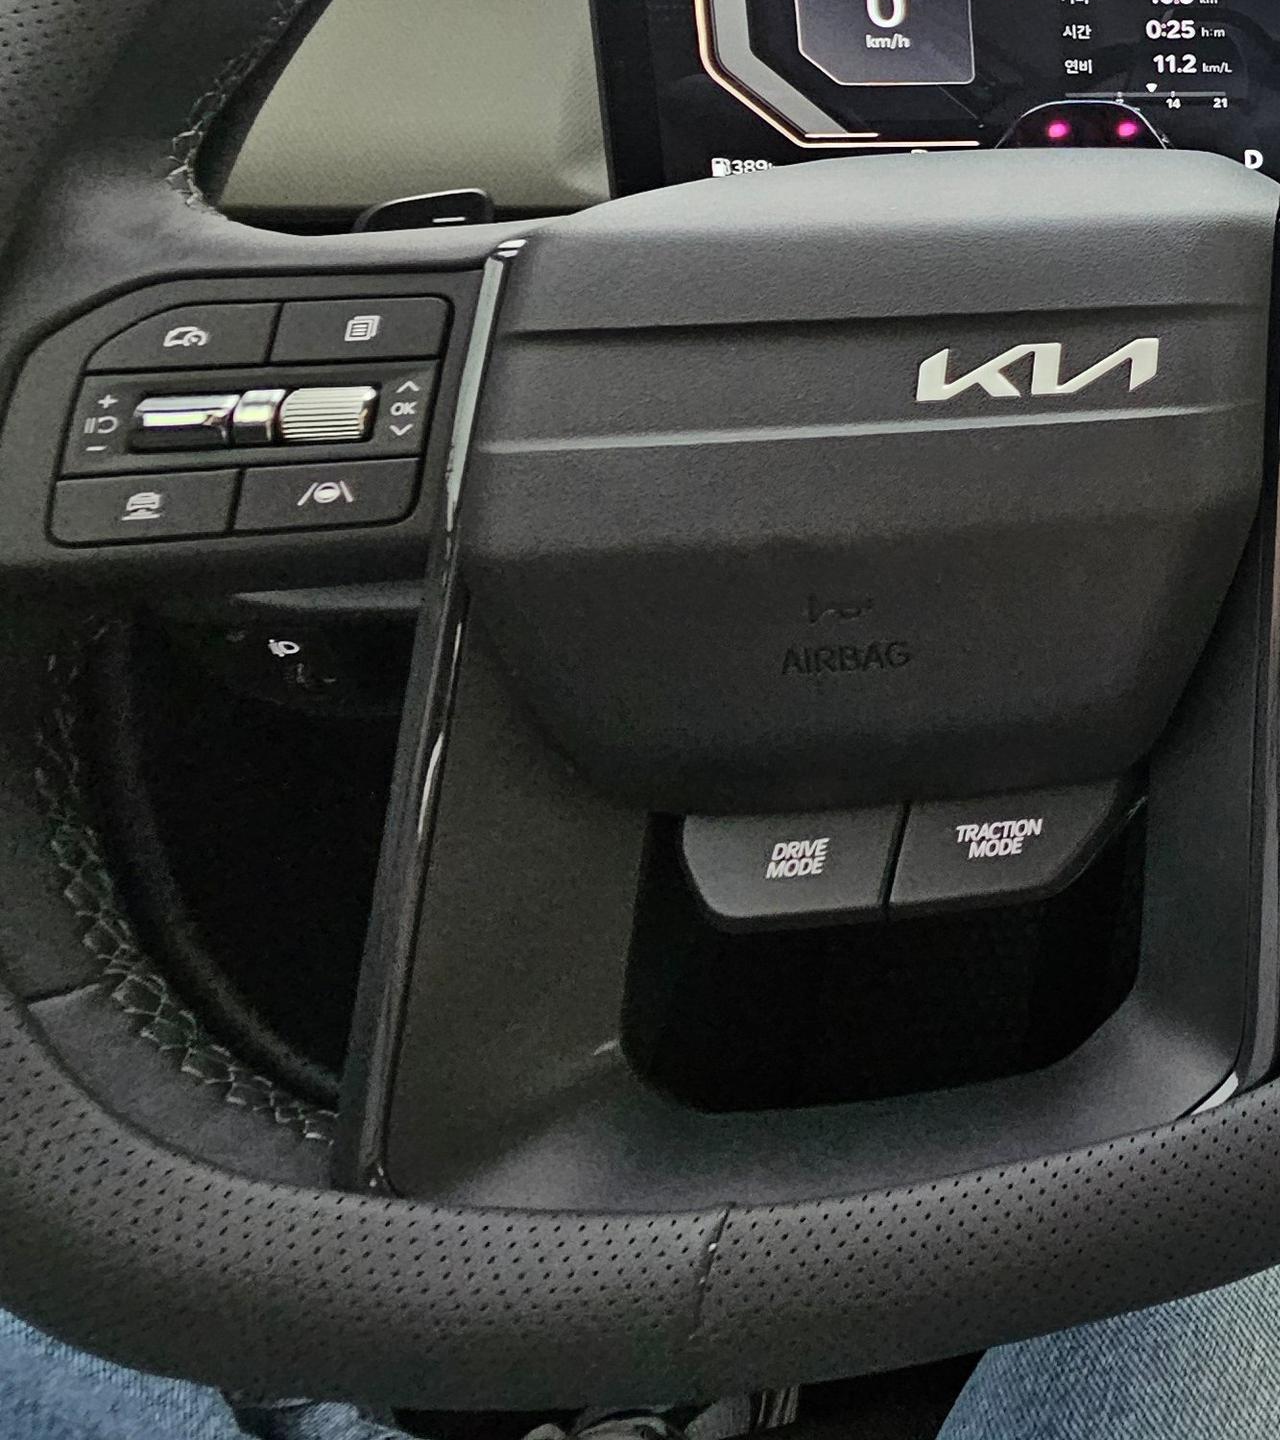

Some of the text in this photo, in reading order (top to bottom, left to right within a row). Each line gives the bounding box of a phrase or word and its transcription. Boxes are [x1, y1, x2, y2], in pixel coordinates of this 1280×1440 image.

[1062, 19, 1226, 40] 시간 0:25 h:m
[865, 34, 911, 50] km/h
[1064, 54, 1232, 74] 연비 11.2 km/L
[1166, 98, 1182, 109] 14
[1213, 98, 1229, 109] 21
[731, 159, 775, 175] 389
[1244, 149, 1264, 170] D
[915, 337, 1160, 402] KIA
[390, 401, 418, 416] OK
[780, 641, 912, 676] AIRBAG
[956, 818, 1043, 843] TRACTION
[771, 837, 831, 861] DRIVE
[967, 836, 1024, 859] MODE
[765, 857, 826, 879] MODE
